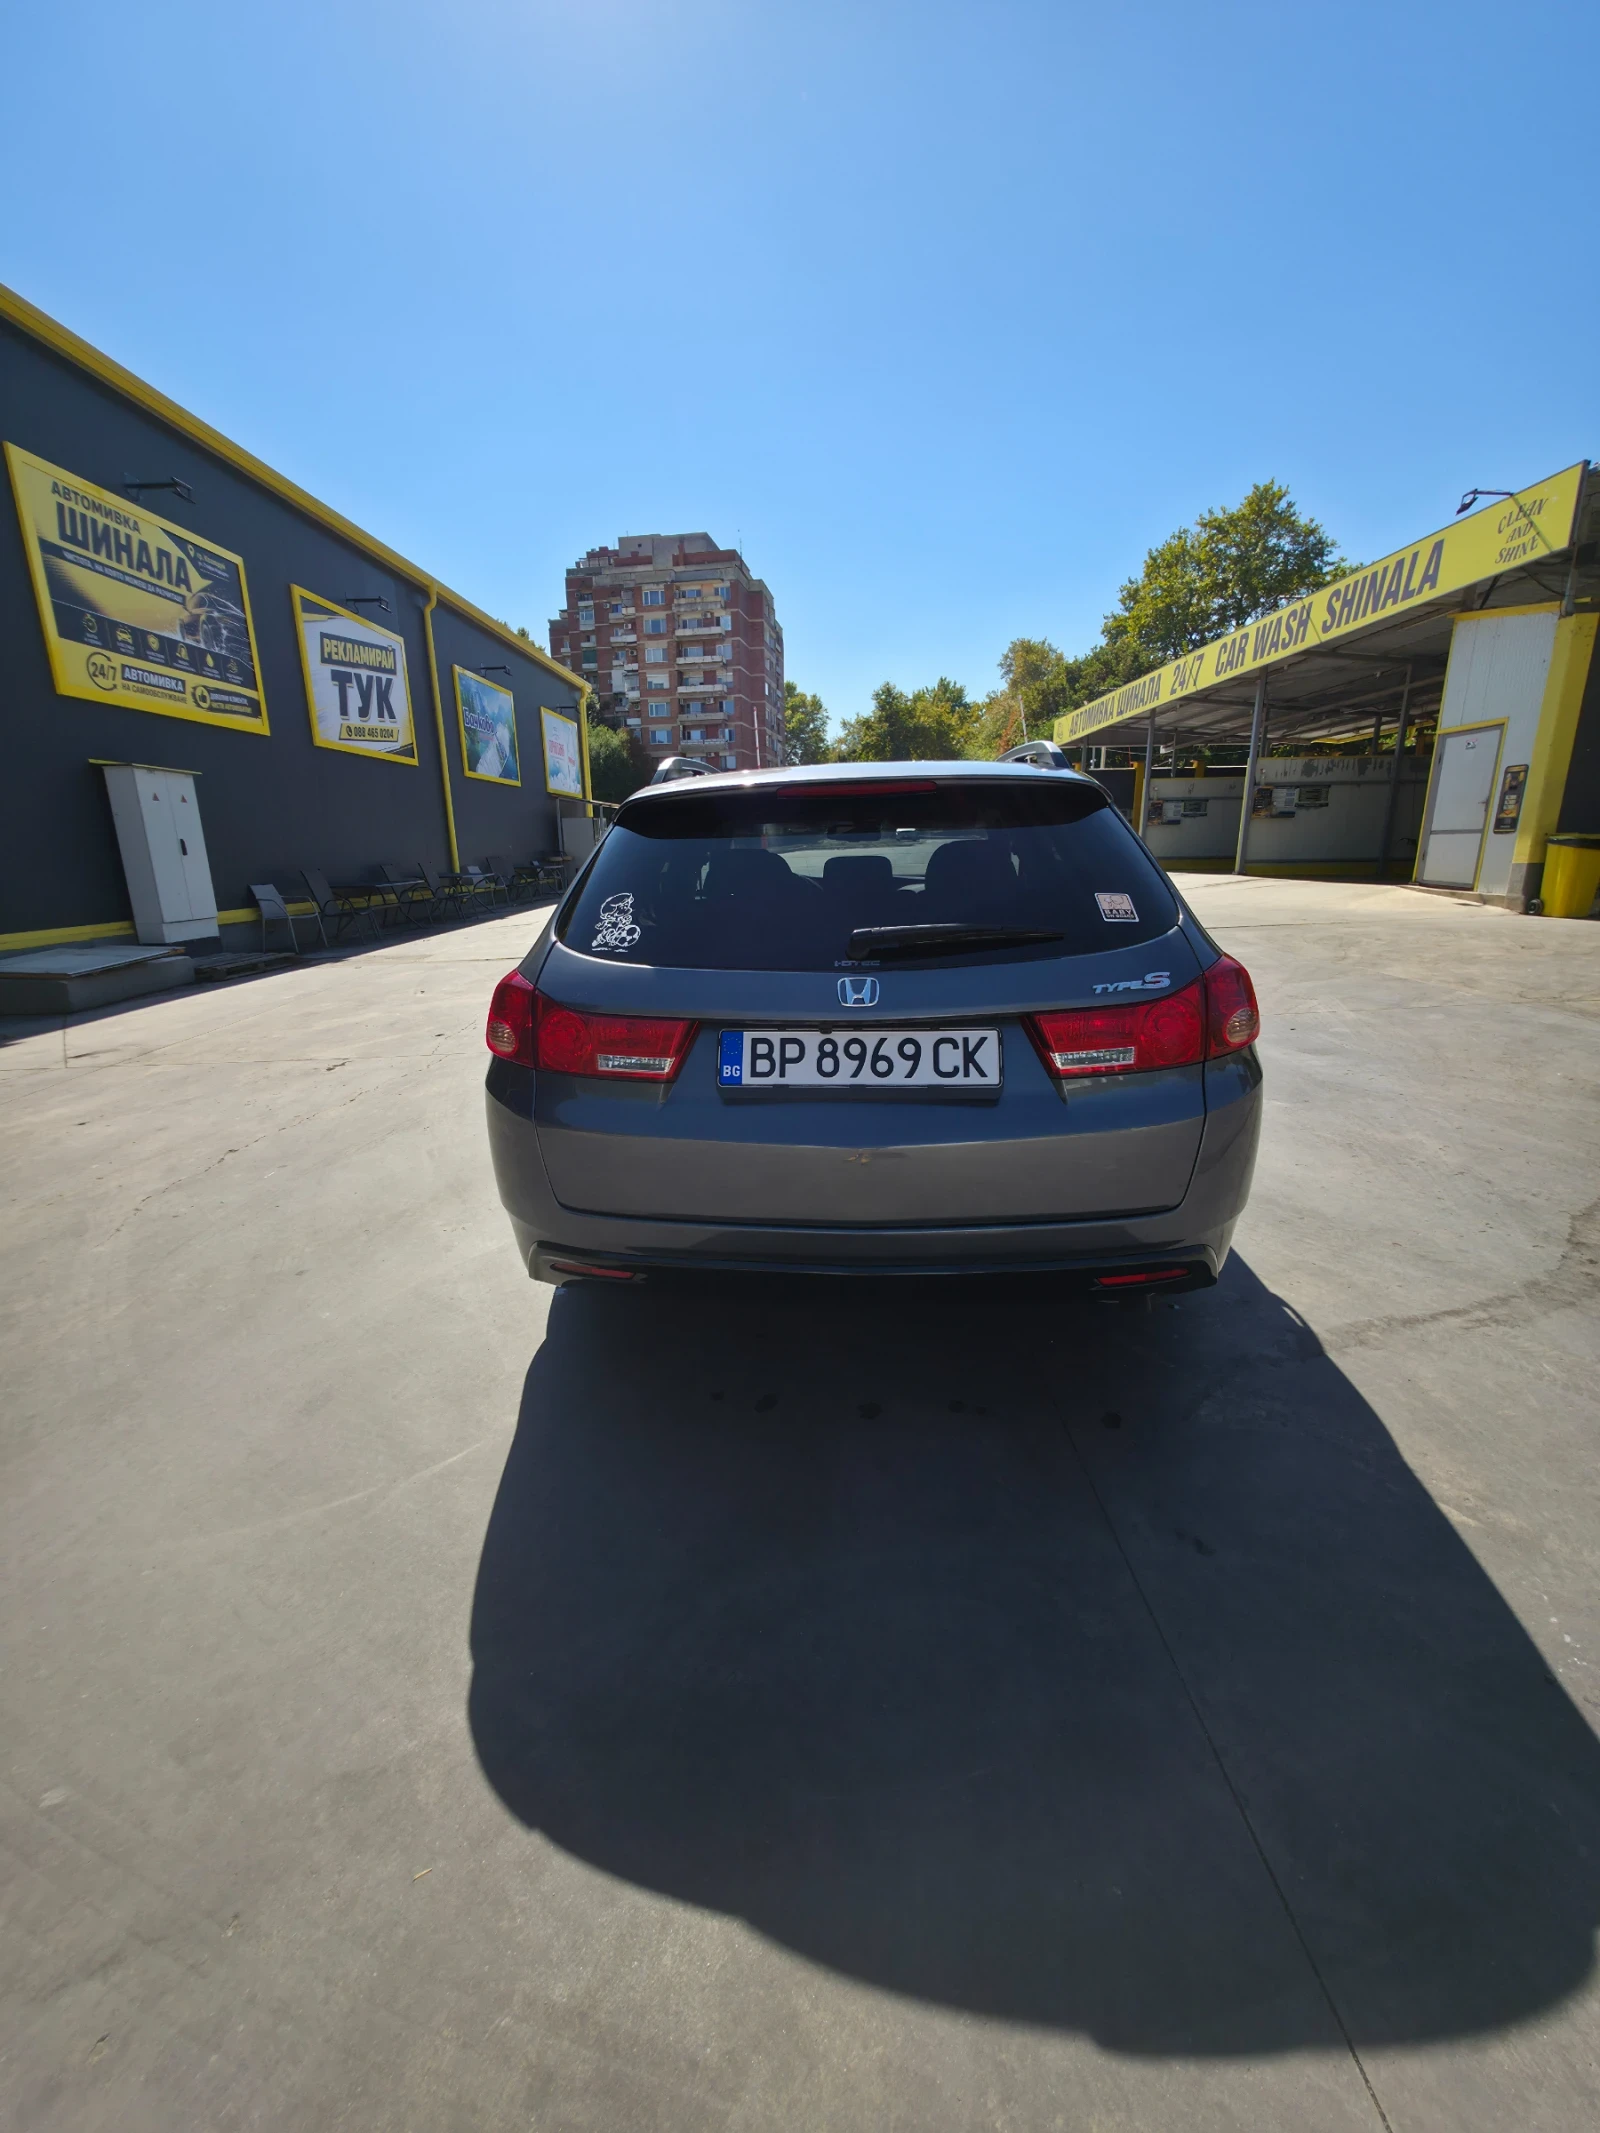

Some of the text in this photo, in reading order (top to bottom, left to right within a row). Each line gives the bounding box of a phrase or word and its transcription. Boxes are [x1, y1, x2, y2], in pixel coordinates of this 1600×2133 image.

[52, 480, 141, 535] АВТОМИВКА
[1497, 498, 1549, 534] CLEAN
[56, 500, 192, 593] ШИНАЛА
[1494, 534, 1538, 564] SHINE
[1506, 521, 1534, 544] AND
[323, 637, 395, 669] РЕКЛАМИРАЙ
[1068, 539, 1444, 738] АВТОМИВКА ШИНАЛА 24/7 CAR WASH SHINALA
[91, 661, 117, 681] 24/7
[123, 667, 184, 692] АВТОМИВКА
[331, 669, 397, 721] ТУК
[1092, 971, 1170, 994] TYPE S
[723, 1037, 988, 1078] BG BP 8969 CK
